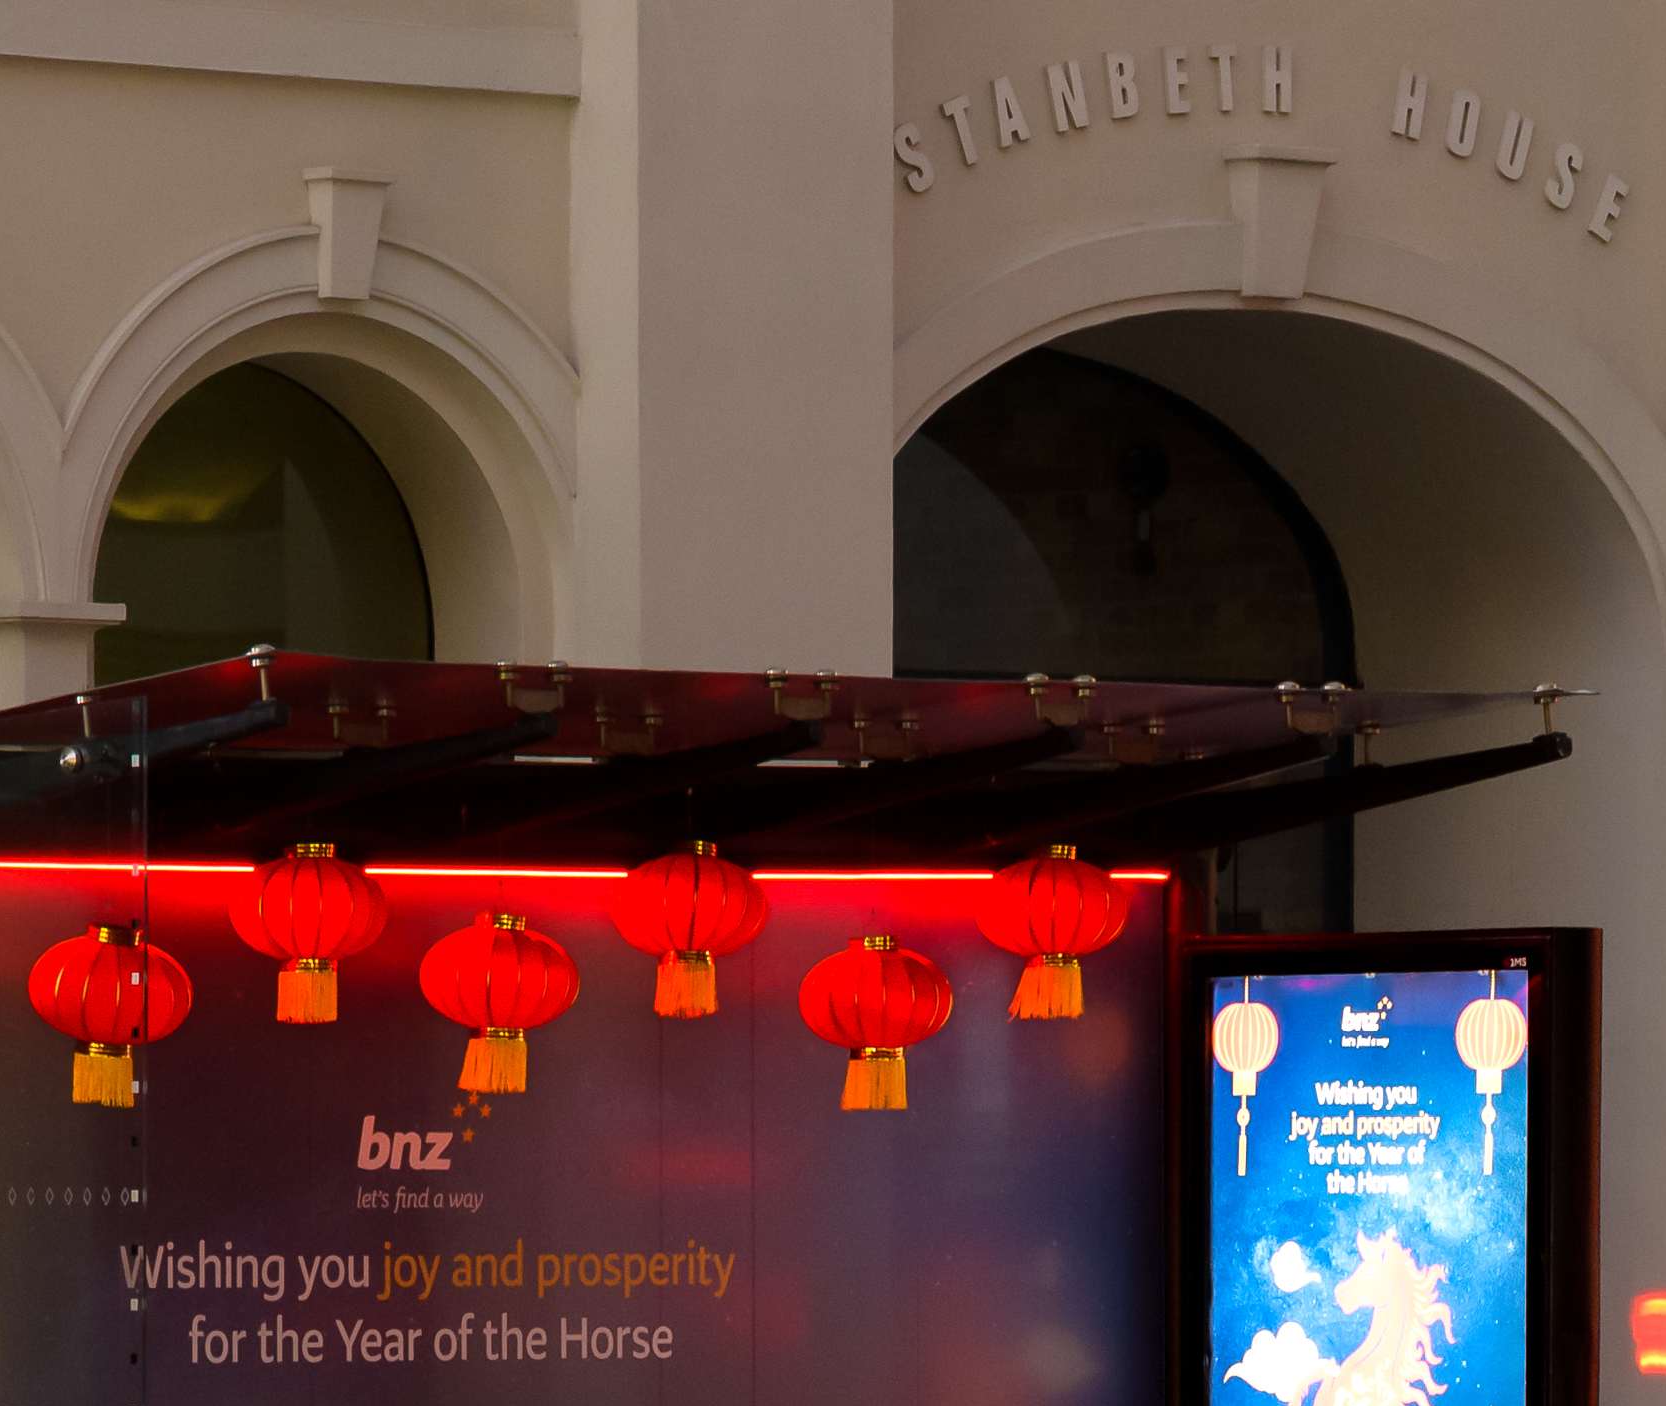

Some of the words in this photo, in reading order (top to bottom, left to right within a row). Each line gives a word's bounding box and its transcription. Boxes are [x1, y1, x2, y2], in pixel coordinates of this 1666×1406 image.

[894, 45, 1293, 193] STANBETH
[1391, 67, 1629, 244] HOUSE
[1341, 1005, 1380, 1031] bnz
[1315, 1080, 1383, 1110] Wishing
[1384, 1086, 1418, 1110] you
[1288, 1111, 1318, 1141] joy
[1320, 1110, 1354, 1136] and
[1356, 1110, 1440, 1139] prosperity
[357, 1116, 454, 1170] bnz
[1308, 1140, 1335, 1165] for
[1336, 1139, 1365, 1165] the
[1367, 1141, 1405, 1165] Year
[1407, 1139, 1426, 1165] of
[1326, 1169, 1356, 1194] the
[1357, 1170, 1409, 1194] Horse
[393, 1186, 430, 1213] find
[433, 1192, 444, 1210] a
[448, 1192, 484, 1213] way
[120, 1240, 286, 1301] Wishing
[297, 1254, 370, 1301] you
[377, 1241, 440, 1300] joy
[451, 1238, 523, 1288] and
[537, 1239, 736, 1299] prosperity
[189, 1314, 247, 1364] for
[257, 1314, 323, 1363] the
[336, 1317, 422, 1363] Year
[433, 1313, 478, 1361] of
[483, 1313, 547, 1361] the
[560, 1316, 674, 1361] Horse
